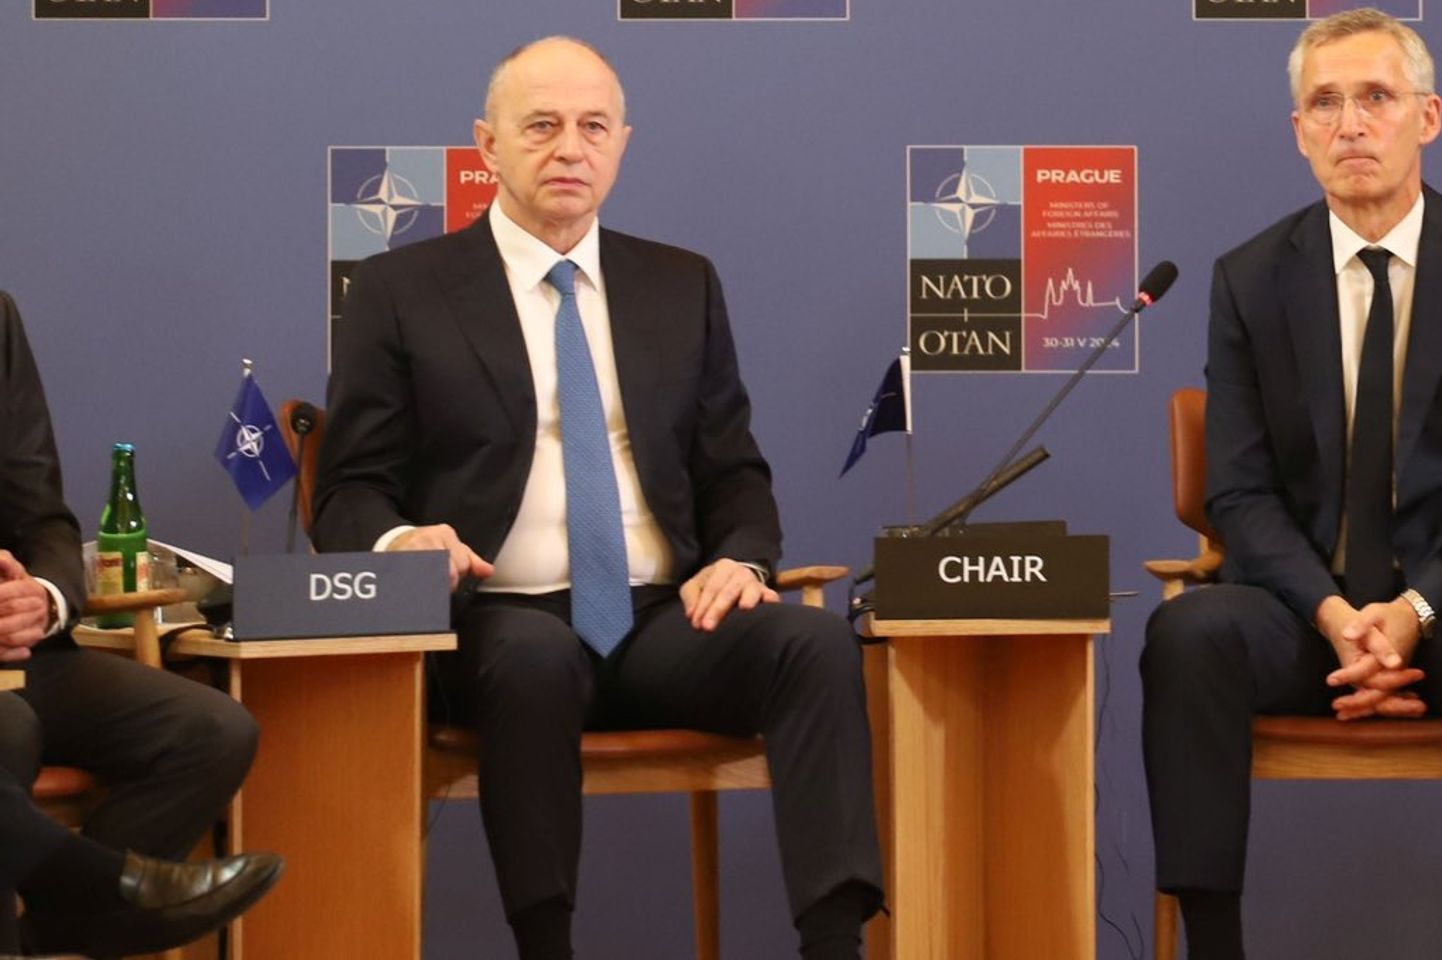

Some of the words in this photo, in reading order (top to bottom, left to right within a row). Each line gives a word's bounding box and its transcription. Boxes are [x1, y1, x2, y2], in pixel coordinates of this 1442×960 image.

[1036, 169, 1122, 183] PRAGUE
[920, 274, 1011, 299] NATO
[918, 330, 1012, 355] OTAN
[1042, 337, 1074, 347] 30-31
[1076, 337, 1086, 347] V
[1088, 337, 1119, 347] 204
[938, 555, 1047, 583] CHAIR
[309, 571, 377, 601] DSG
